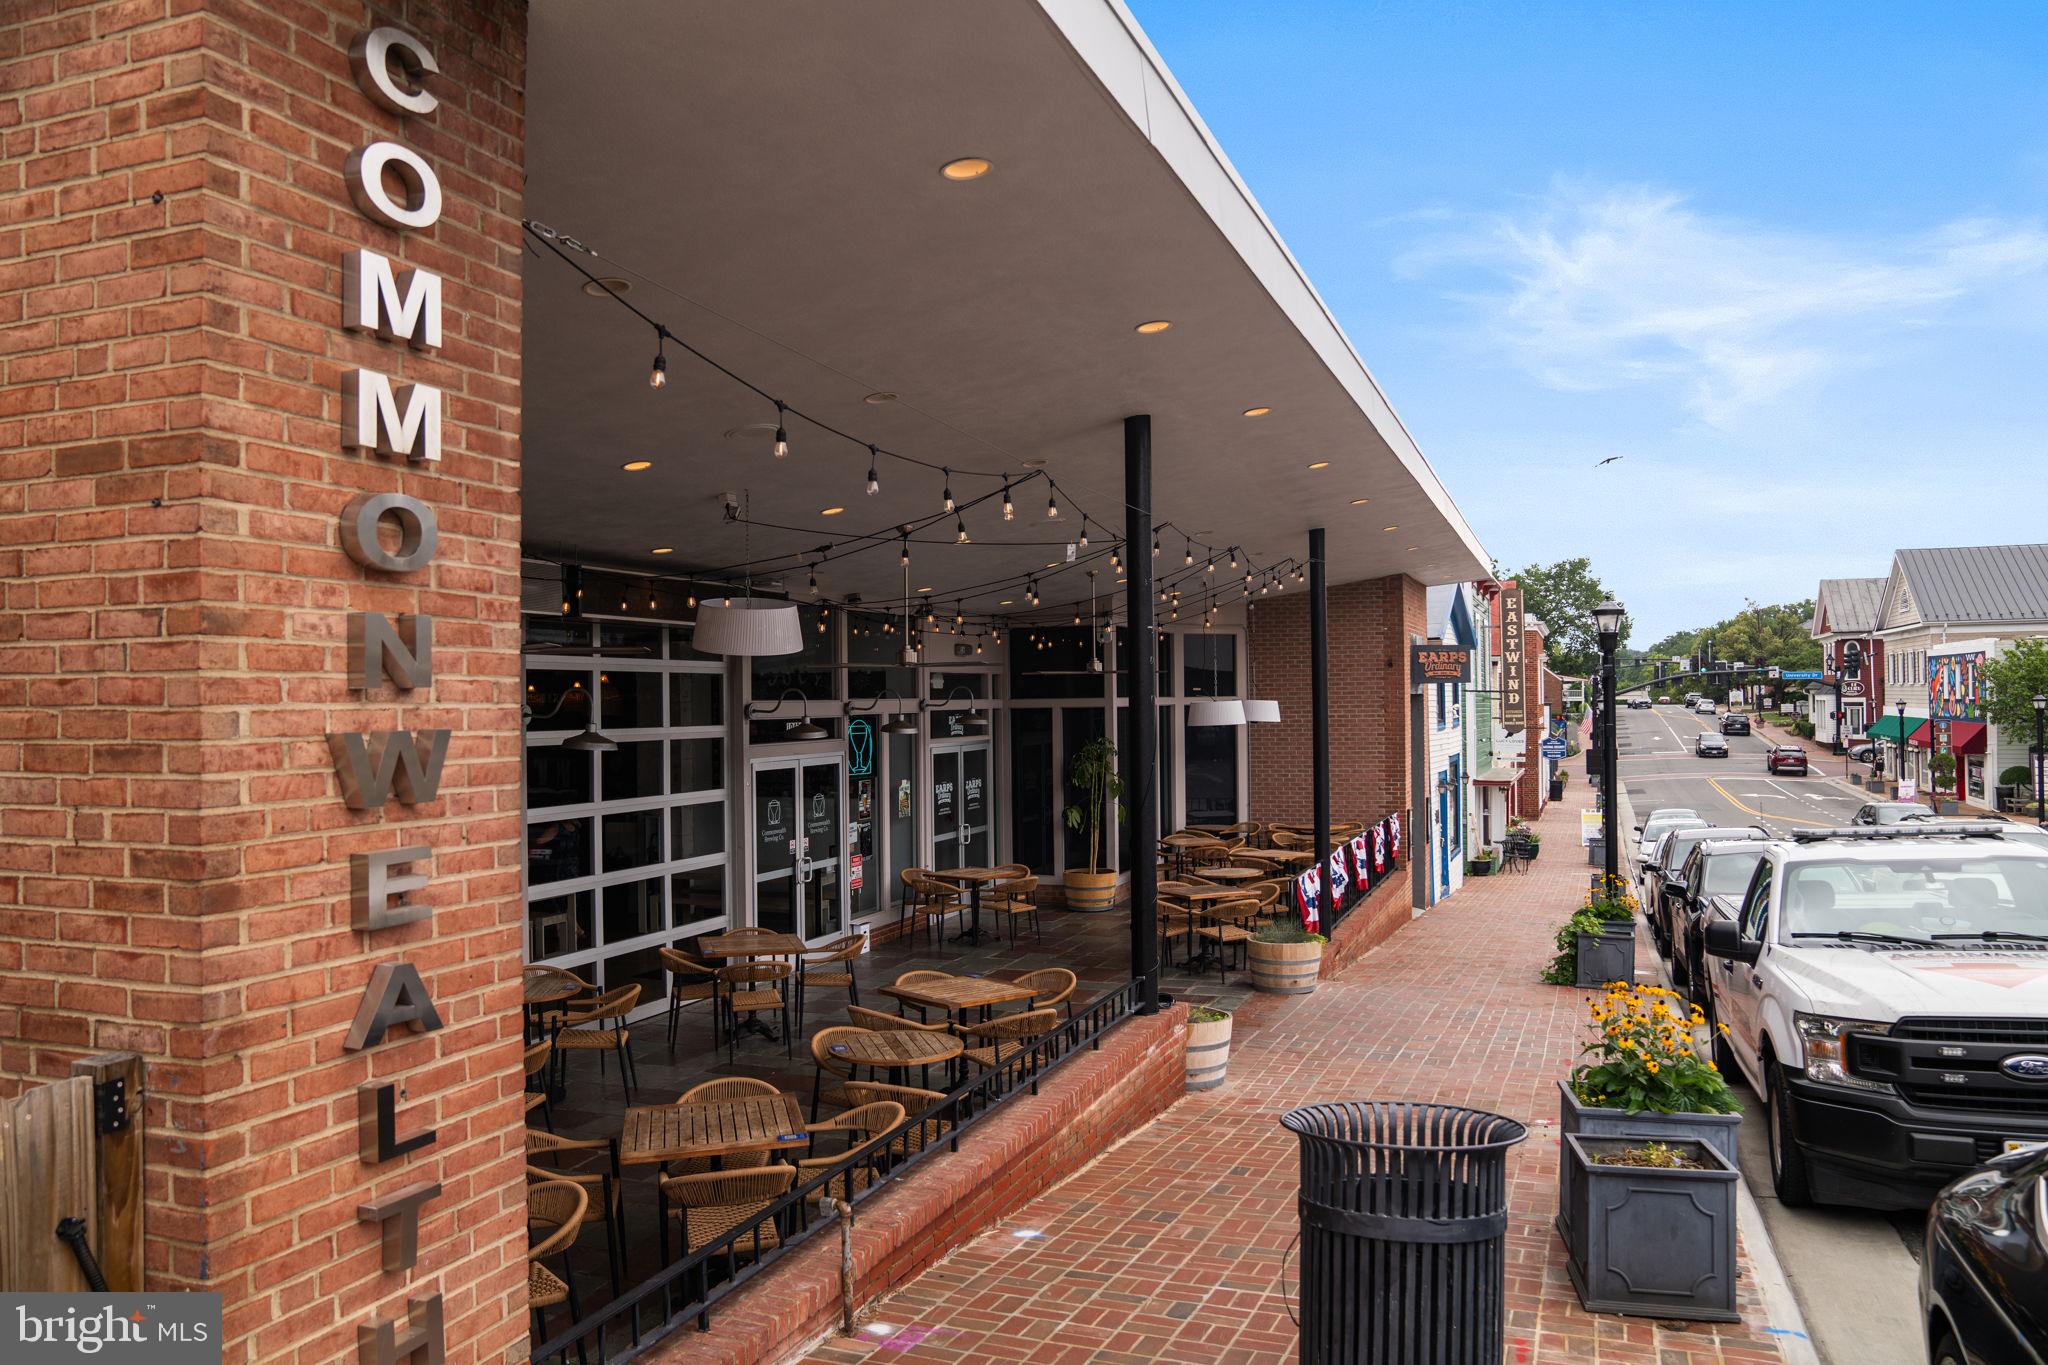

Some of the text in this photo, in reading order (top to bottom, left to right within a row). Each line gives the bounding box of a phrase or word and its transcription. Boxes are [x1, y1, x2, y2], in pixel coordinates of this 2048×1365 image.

[1418, 651, 1468, 663] EARPS
[1505, 598, 1520, 704] EASTWIND
[1425, 660, 1461, 672] Ordinary
[935, 782, 953, 794] EARPS
